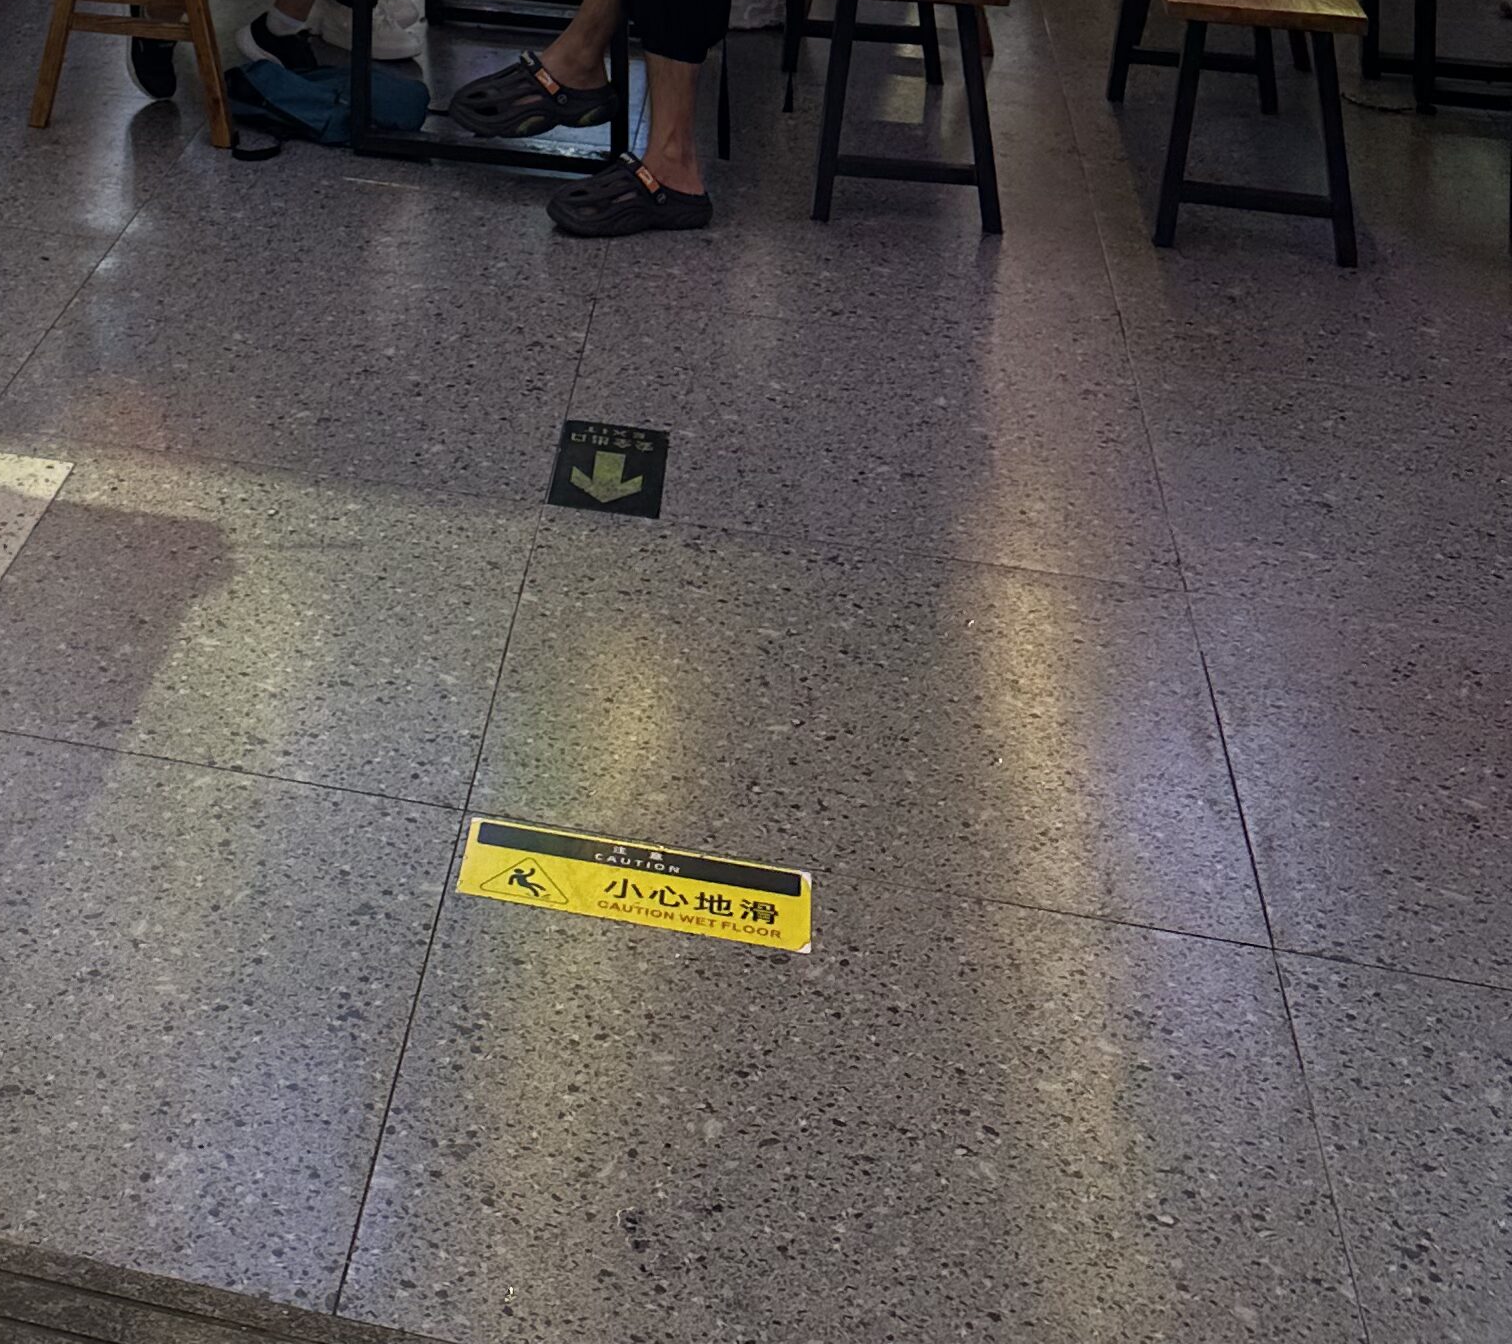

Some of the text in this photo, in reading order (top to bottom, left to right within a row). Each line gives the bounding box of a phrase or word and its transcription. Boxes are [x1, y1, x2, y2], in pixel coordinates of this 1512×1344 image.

[594, 852, 682, 875] CAUTION
[612, 844, 666, 861] 注意
[604, 878, 780, 925] 小心地滑
[597, 899, 783, 941] CAUTION WET FLOOR
